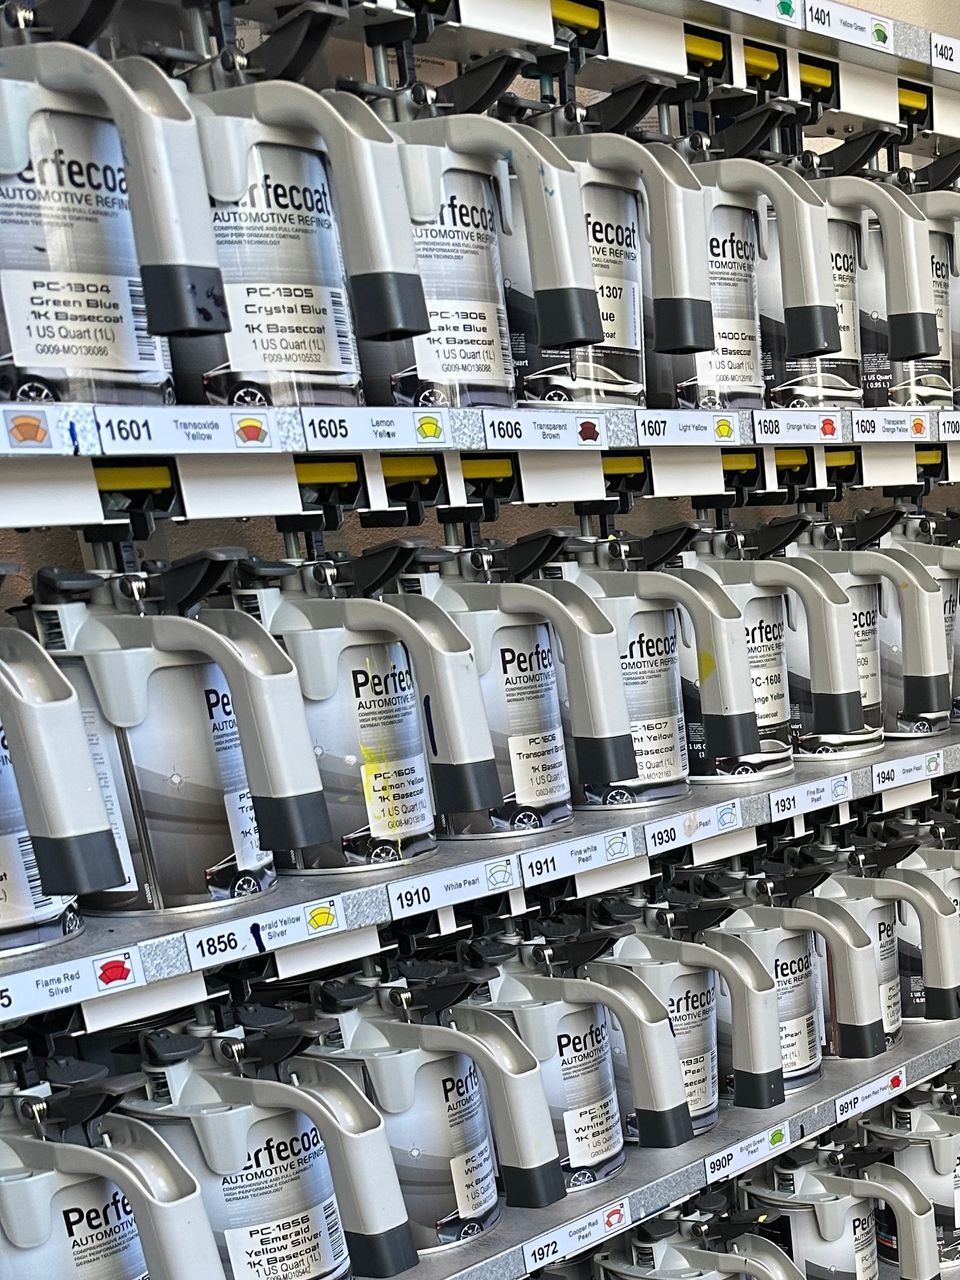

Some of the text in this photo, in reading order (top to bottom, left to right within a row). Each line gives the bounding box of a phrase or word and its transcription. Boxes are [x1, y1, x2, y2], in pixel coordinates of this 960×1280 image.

[809, 6, 831, 27] 1401
[934, 43, 954, 62] 1402
[213, 212, 295, 224] AUTOMOTIVE
[32, 281, 111, 294] PC-1304
[246, 287, 314, 298] PC-1305
[30, 296, 120, 310] Green Blue
[245, 304, 328, 316] Crystal Blue
[55, 312, 123, 323] Basecoat
[429, 312, 486, 320] PC-1306
[37, 326, 115, 343] US Quart (1L)
[245, 324, 325, 334] 1K Basecoat
[463, 324, 487, 333] Blue
[261, 339, 325, 351] US Quart (1L)
[446, 338, 495, 346] Basecoat
[443, 349, 481, 361] US Quart
[105, 418, 152, 441] 1601
[173, 419, 219, 430] Transoxide
[308, 418, 348, 439] 1605
[371, 417, 394, 428] Lemon
[490, 420, 522, 439] 1606
[533, 421, 567, 432] Transparent
[641, 420, 667, 437] 1607
[757, 419, 780, 436] 1608
[855, 419, 876, 434] 1609
[942, 420, 960, 434] 1700
[185, 430, 212, 441] Yellow
[542, 430, 560, 440] Brown
[358, 694, 410, 710] AUTOMOTIVE
[528, 733, 556, 745] PC-1606
[648, 732, 673, 742] Yellow
[645, 760, 664, 769] Quart
[374, 767, 415, 781] PC-1605
[877, 769, 895, 785] 1940
[807, 789, 816, 797] Fine
[775, 796, 797, 814] 1931
[651, 827, 676, 847] 1930
[570, 848, 582, 857] Fine
[528, 856, 557, 877] 1911
[463, 877, 480, 888] Pearl
[396, 887, 431, 909] 1910
[267, 929, 287, 940] Silver
[196, 932, 238, 958] 1856
[35, 970, 80, 991] Flame Red
[48, 983, 74, 997] Silver
[839, 1096, 859, 1116] 991P
[590, 1110, 610, 1122] Fine
[574, 1119, 604, 1134] White
[710, 1152, 734, 1174] 990P
[222, 1161, 295, 1186] AUTOMOTIVE
[250, 1215, 310, 1238] PC-1856
[260, 1225, 310, 1246] Emerald
[578, 1231, 591, 1241] Pearl
[245, 1230, 322, 1258] Yellow Silver
[247, 1243, 320, 1268] 1K Basecoat
[531, 1240, 558, 1263] 1972
[265, 1258, 305, 1277] US Quart
